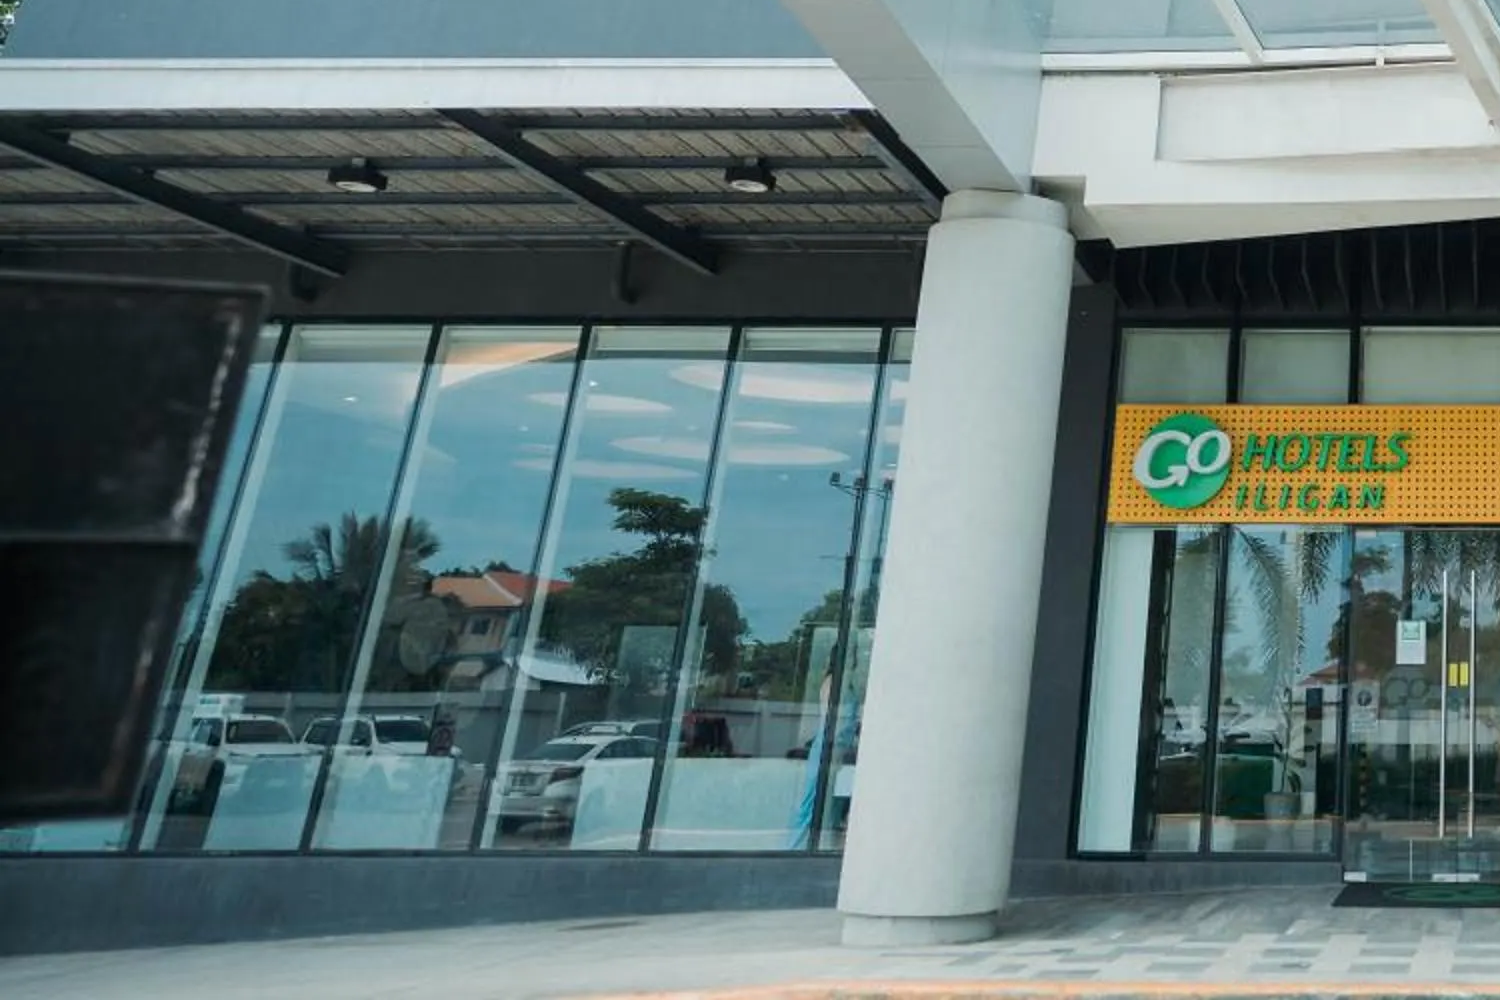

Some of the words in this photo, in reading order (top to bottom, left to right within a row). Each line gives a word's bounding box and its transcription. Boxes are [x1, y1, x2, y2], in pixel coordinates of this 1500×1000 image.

[1132, 430, 1232, 489] GO
[1242, 433, 1411, 473] HOTELS
[1235, 483, 1384, 511] ILIGAN
